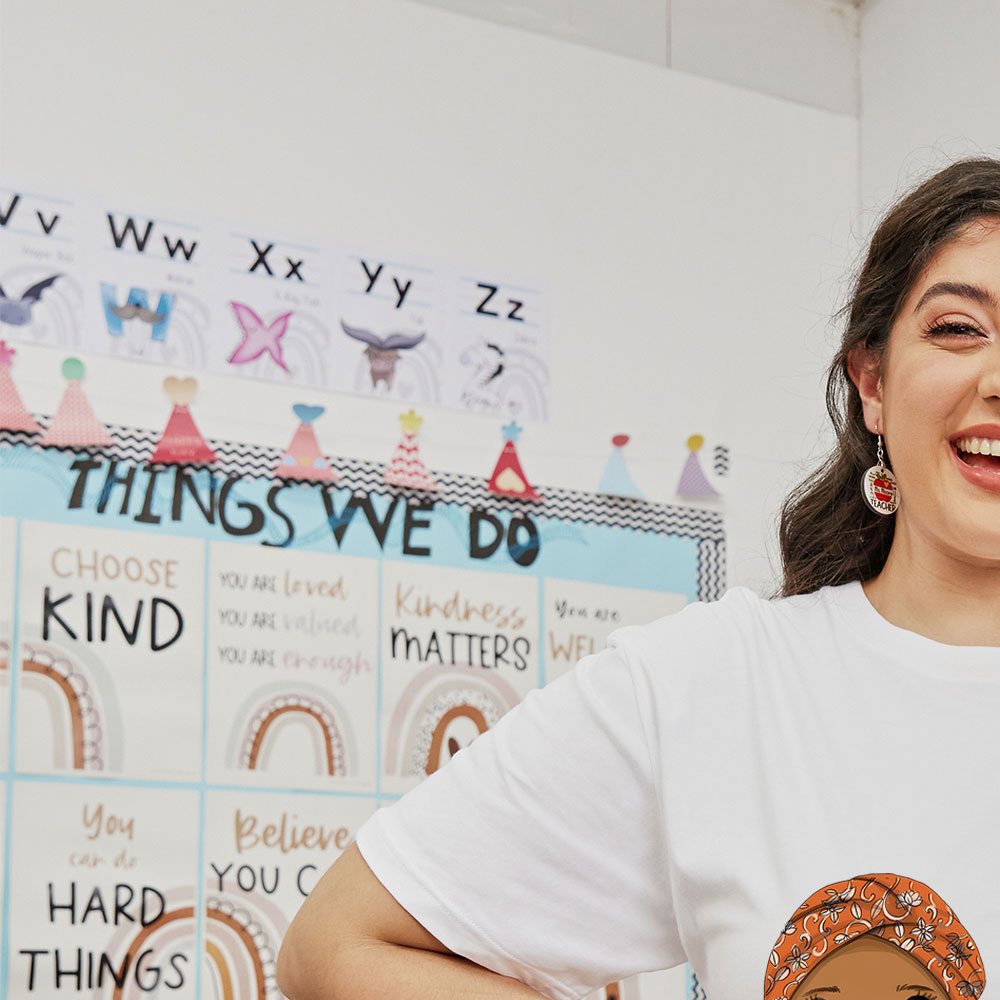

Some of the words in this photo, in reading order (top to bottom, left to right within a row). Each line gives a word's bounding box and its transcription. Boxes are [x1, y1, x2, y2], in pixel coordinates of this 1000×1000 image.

[107, 212, 153, 252] W
[163, 235, 197, 261] w
[249, 239, 274, 276] X
[285, 258, 304, 282] x
[360, 259, 383, 293] Y
[393, 277, 411, 309] y
[476, 282, 498, 316] Z
[507, 299, 524, 321] z
[67, 457, 295, 548] THINGS
[321, 486, 434, 556] WE
[469, 507, 540, 567] DO
[52, 546, 178, 589] CHOOSE
[218, 571, 248, 591] YOU
[251, 573, 277, 593] ARE
[283, 568, 347, 600] loved
[42, 586, 184, 652] KIND
[217, 608, 248, 627] YOU
[251, 609, 277, 630] ARE
[395, 580, 526, 630] Kindness
[216, 646, 248, 665] YOU
[251, 647, 276, 667] ARE
[283, 650, 372, 685] enough
[82, 803, 135, 841] You
[234, 808, 352, 854] Believe
[210, 862, 279, 894] YOU
[48, 881, 166, 928] HARD
[19, 948, 189, 991] THINGS
